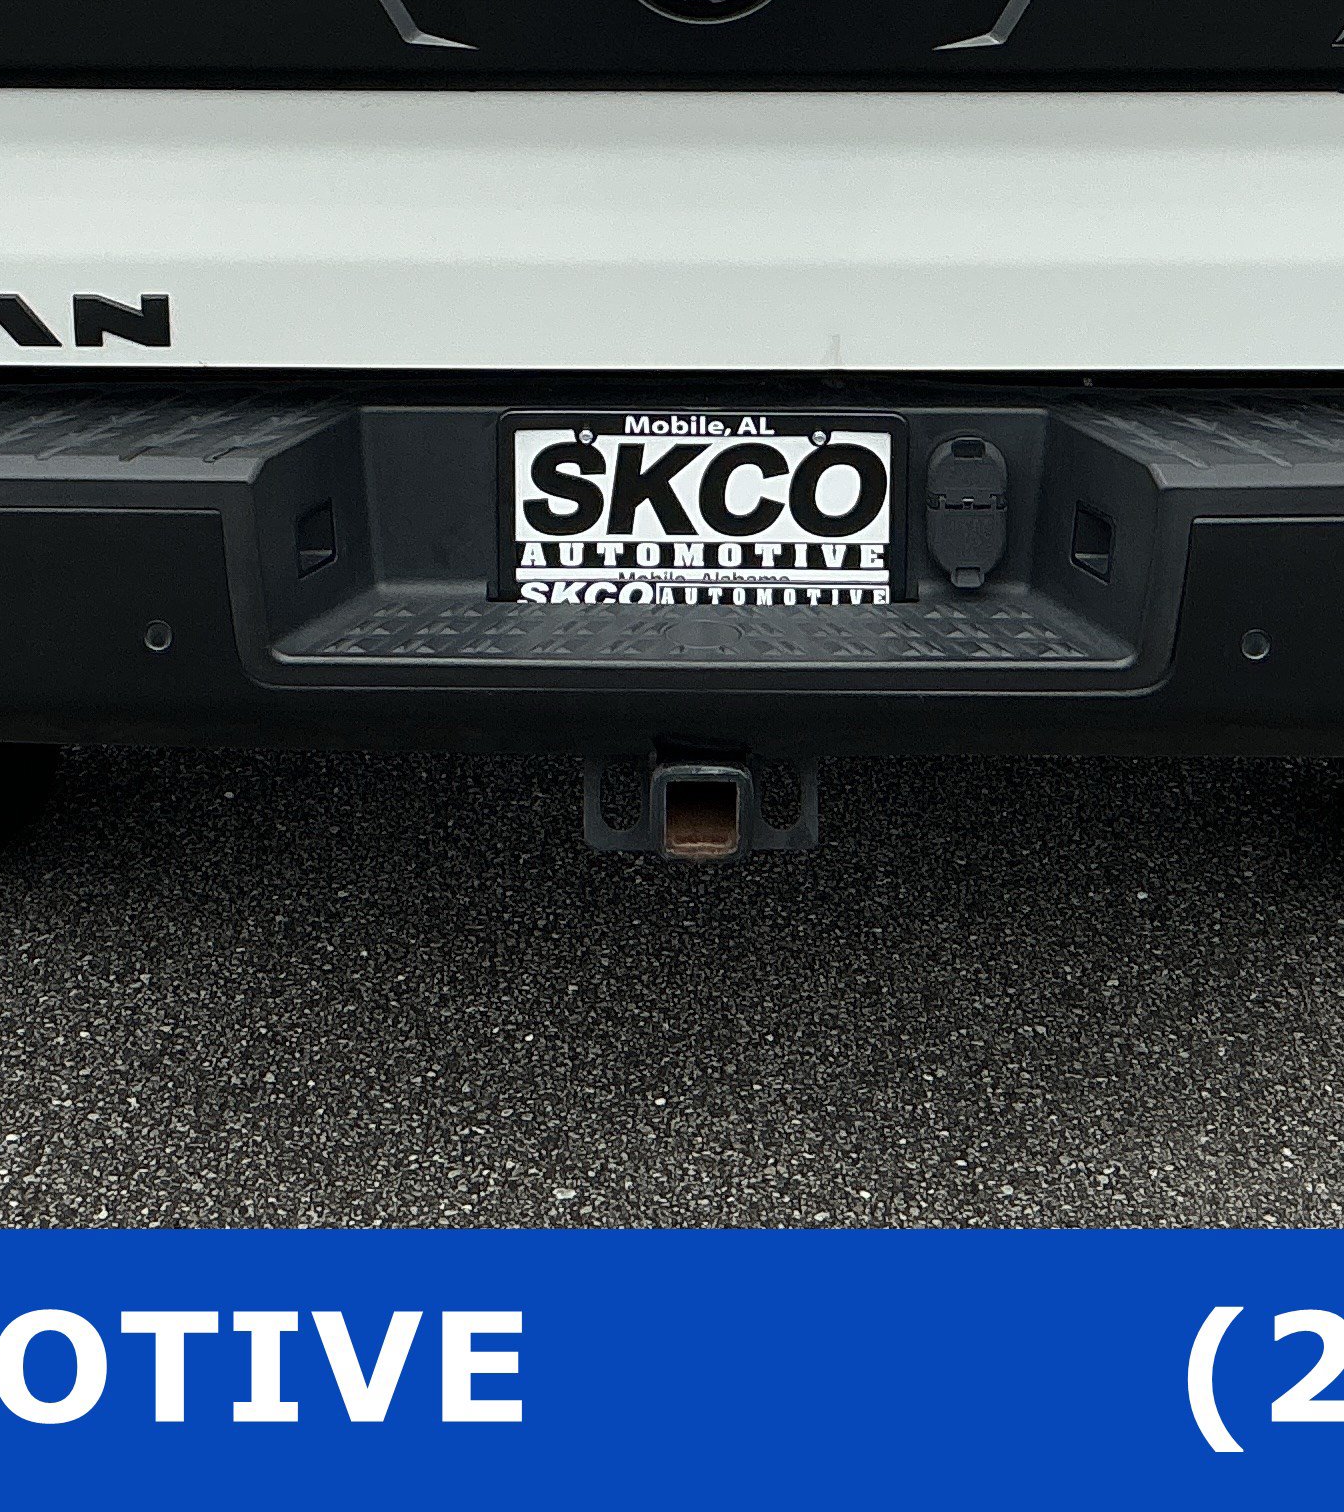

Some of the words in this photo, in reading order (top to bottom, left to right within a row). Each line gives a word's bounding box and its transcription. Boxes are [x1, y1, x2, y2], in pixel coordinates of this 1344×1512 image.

[623, 414, 733, 437] Mobile,
[736, 416, 776, 436] AL
[522, 441, 888, 538] SKCO
[520, 542, 886, 568] AUTOMOTIVE
[660, 587, 886, 606] AUTOMOTIVE
